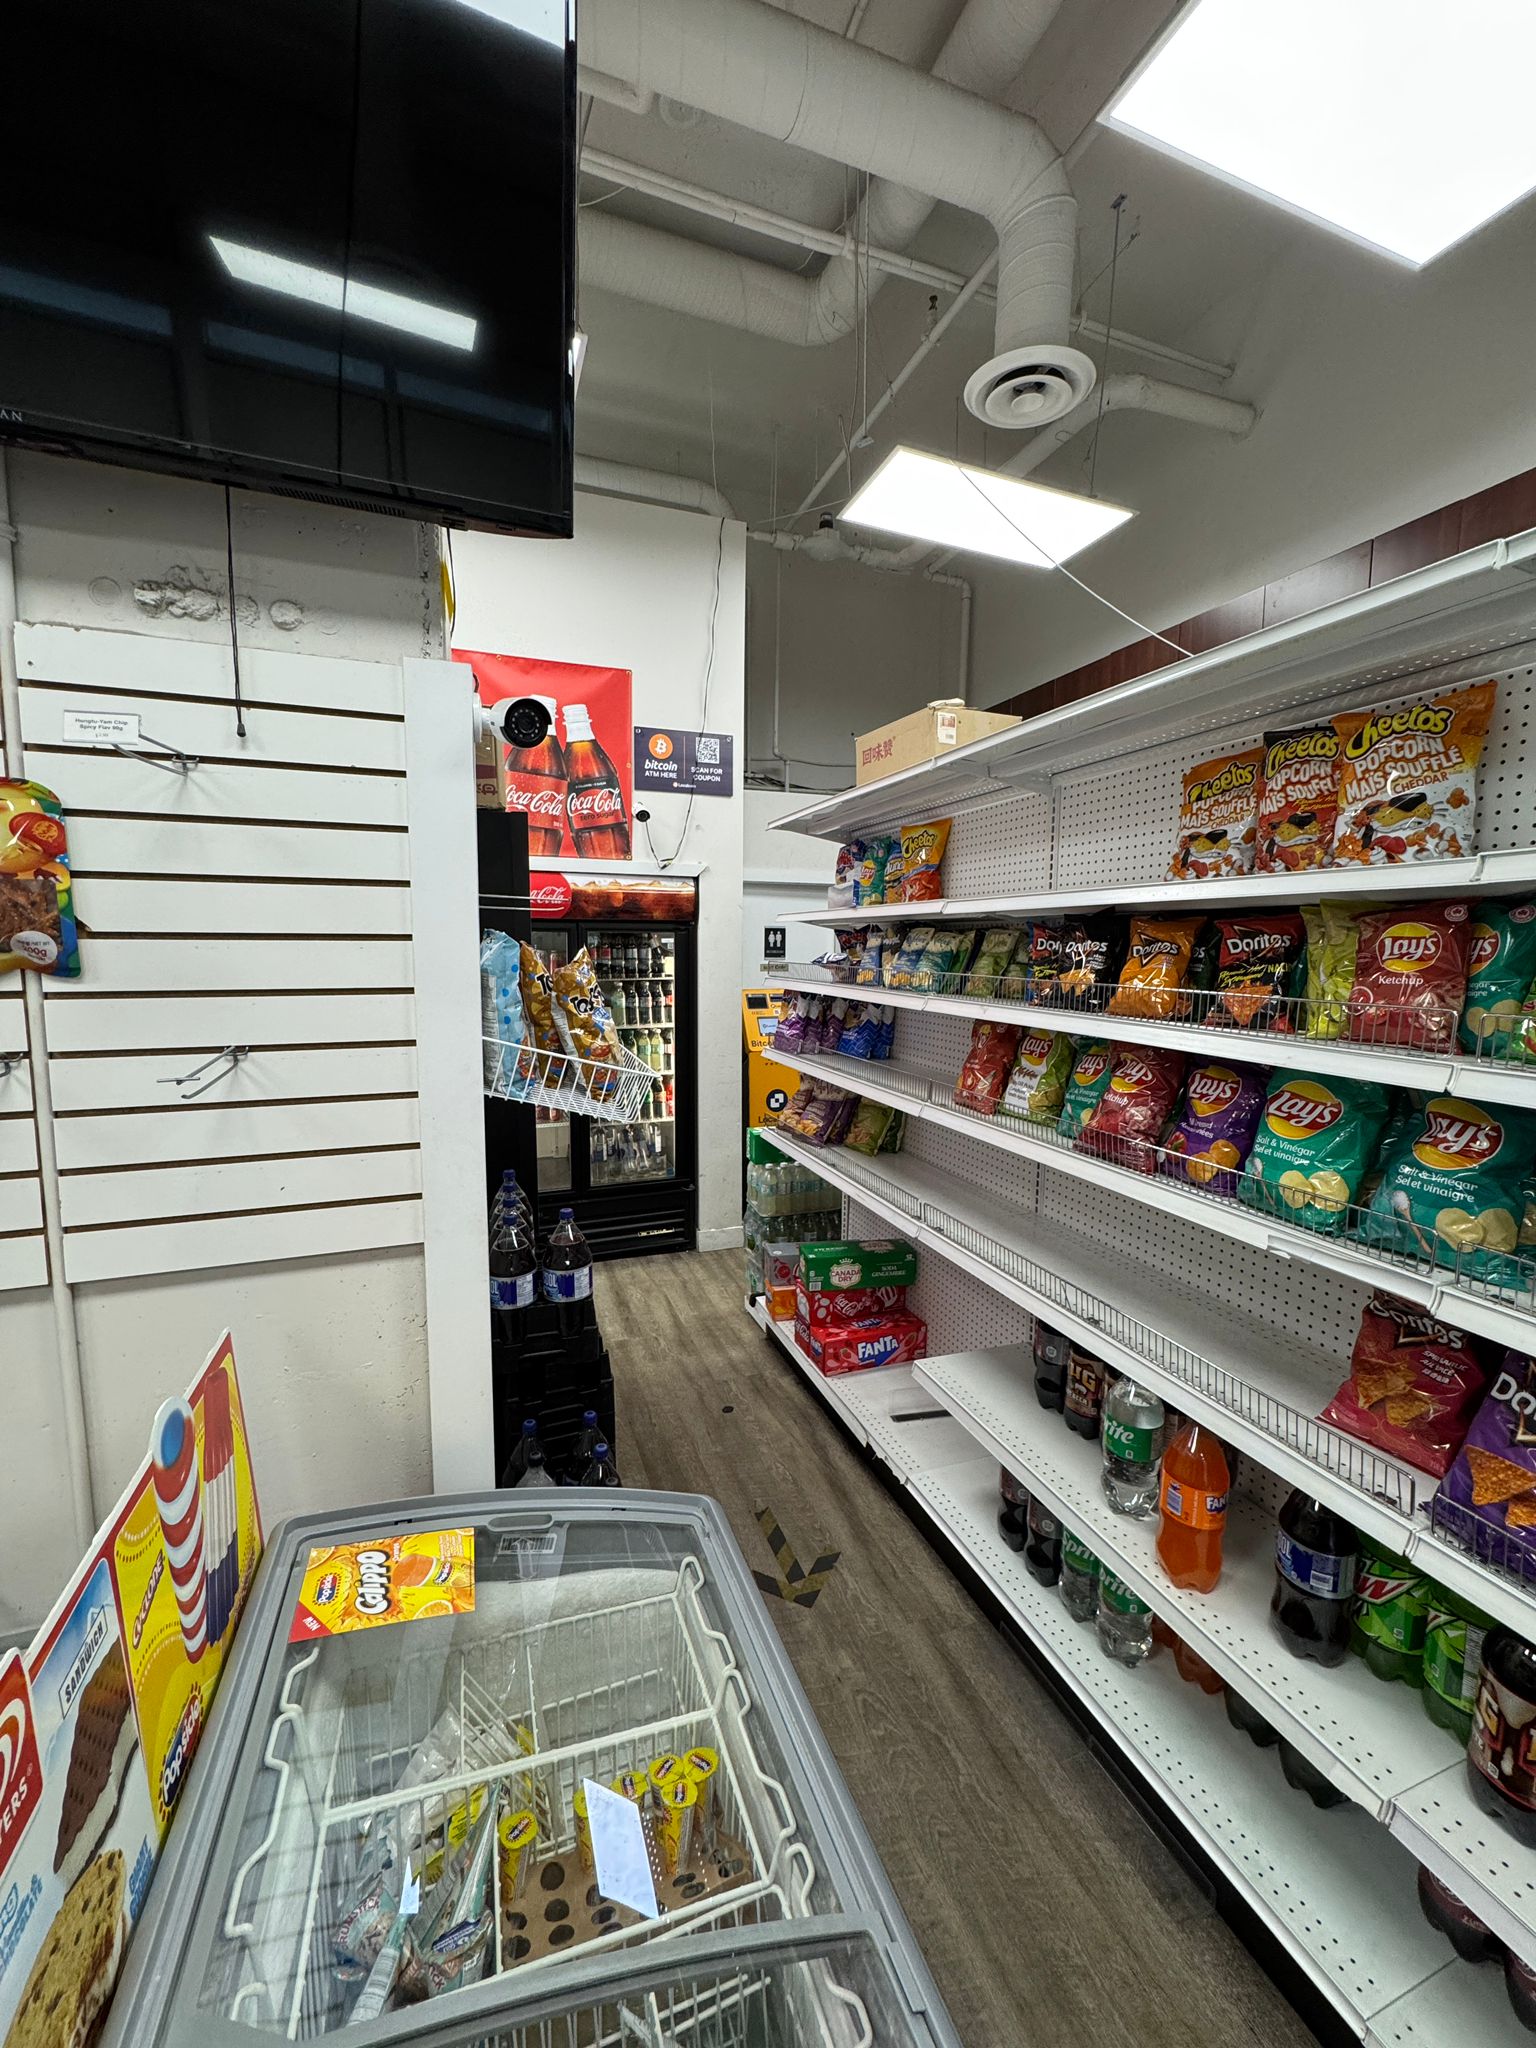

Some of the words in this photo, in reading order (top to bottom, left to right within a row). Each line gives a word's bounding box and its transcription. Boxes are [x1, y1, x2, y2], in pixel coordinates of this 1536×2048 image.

[1344, 703, 1452, 761] Cheetos
[644, 759, 678, 771] bitcoin
[1266, 731, 1340, 781] Cheetos
[1354, 735, 1446, 780] POPCORN
[1384, 744, 1464, 779] SOUFFLÉ
[644, 770, 660, 778] ATM
[690, 766, 709, 774] SCAN
[693, 774, 721, 783] COUPON
[1188, 761, 1257, 804] Cheetos
[1392, 771, 1449, 794] CHEDDAR
[1345, 771, 1387, 804] MAÏS
[505, 784, 566, 817] Coca-Cola
[567, 787, 622, 816] Coca-Cola
[1180, 811, 1210, 830] MAÏS
[902, 830, 938, 859] Cheetos
[1065, 940, 1109, 953] Doritos
[1132, 940, 1180, 958] Doritos
[1227, 934, 1292, 954] Doritos
[1382, 935, 1439, 961] Lay's
[1378, 975, 1424, 987] Ketchup
[1021, 1035, 1052, 1058] Lay's
[1076, 1055, 1107, 1076] Lay's
[1188, 1073, 1239, 1104] Lay's
[1268, 1092, 1339, 1127] Lay's
[1254, 1144, 1264, 1152] Sel
[1273, 1150, 1310, 1166] vinaigre
[1256, 1134, 1271, 1144] Salt
[1272, 1138, 1277, 1147] &
[1279, 1141, 1315, 1157] Vinegar
[1395, 1174, 1410, 1187] Sel
[1410, 1181, 1421, 1190] et
[1423, 1184, 1475, 1203] vinaigre
[1431, 1172, 1478, 1192] Vinegar
[857, 1336, 899, 1359] FANTA
[1069, 1362, 1097, 1392] UG
[1103, 1419, 1135, 1444] rite
[1206, 1495, 1226, 1510] FAN
[317, 1573, 337, 1604] Popsicle
[1101, 1567, 1138, 1599] prite
[303, 1616, 321, 1632] NEW
[64, 1619, 105, 1704] SANDWICH
[163, 1699, 200, 1797] Popsicle
